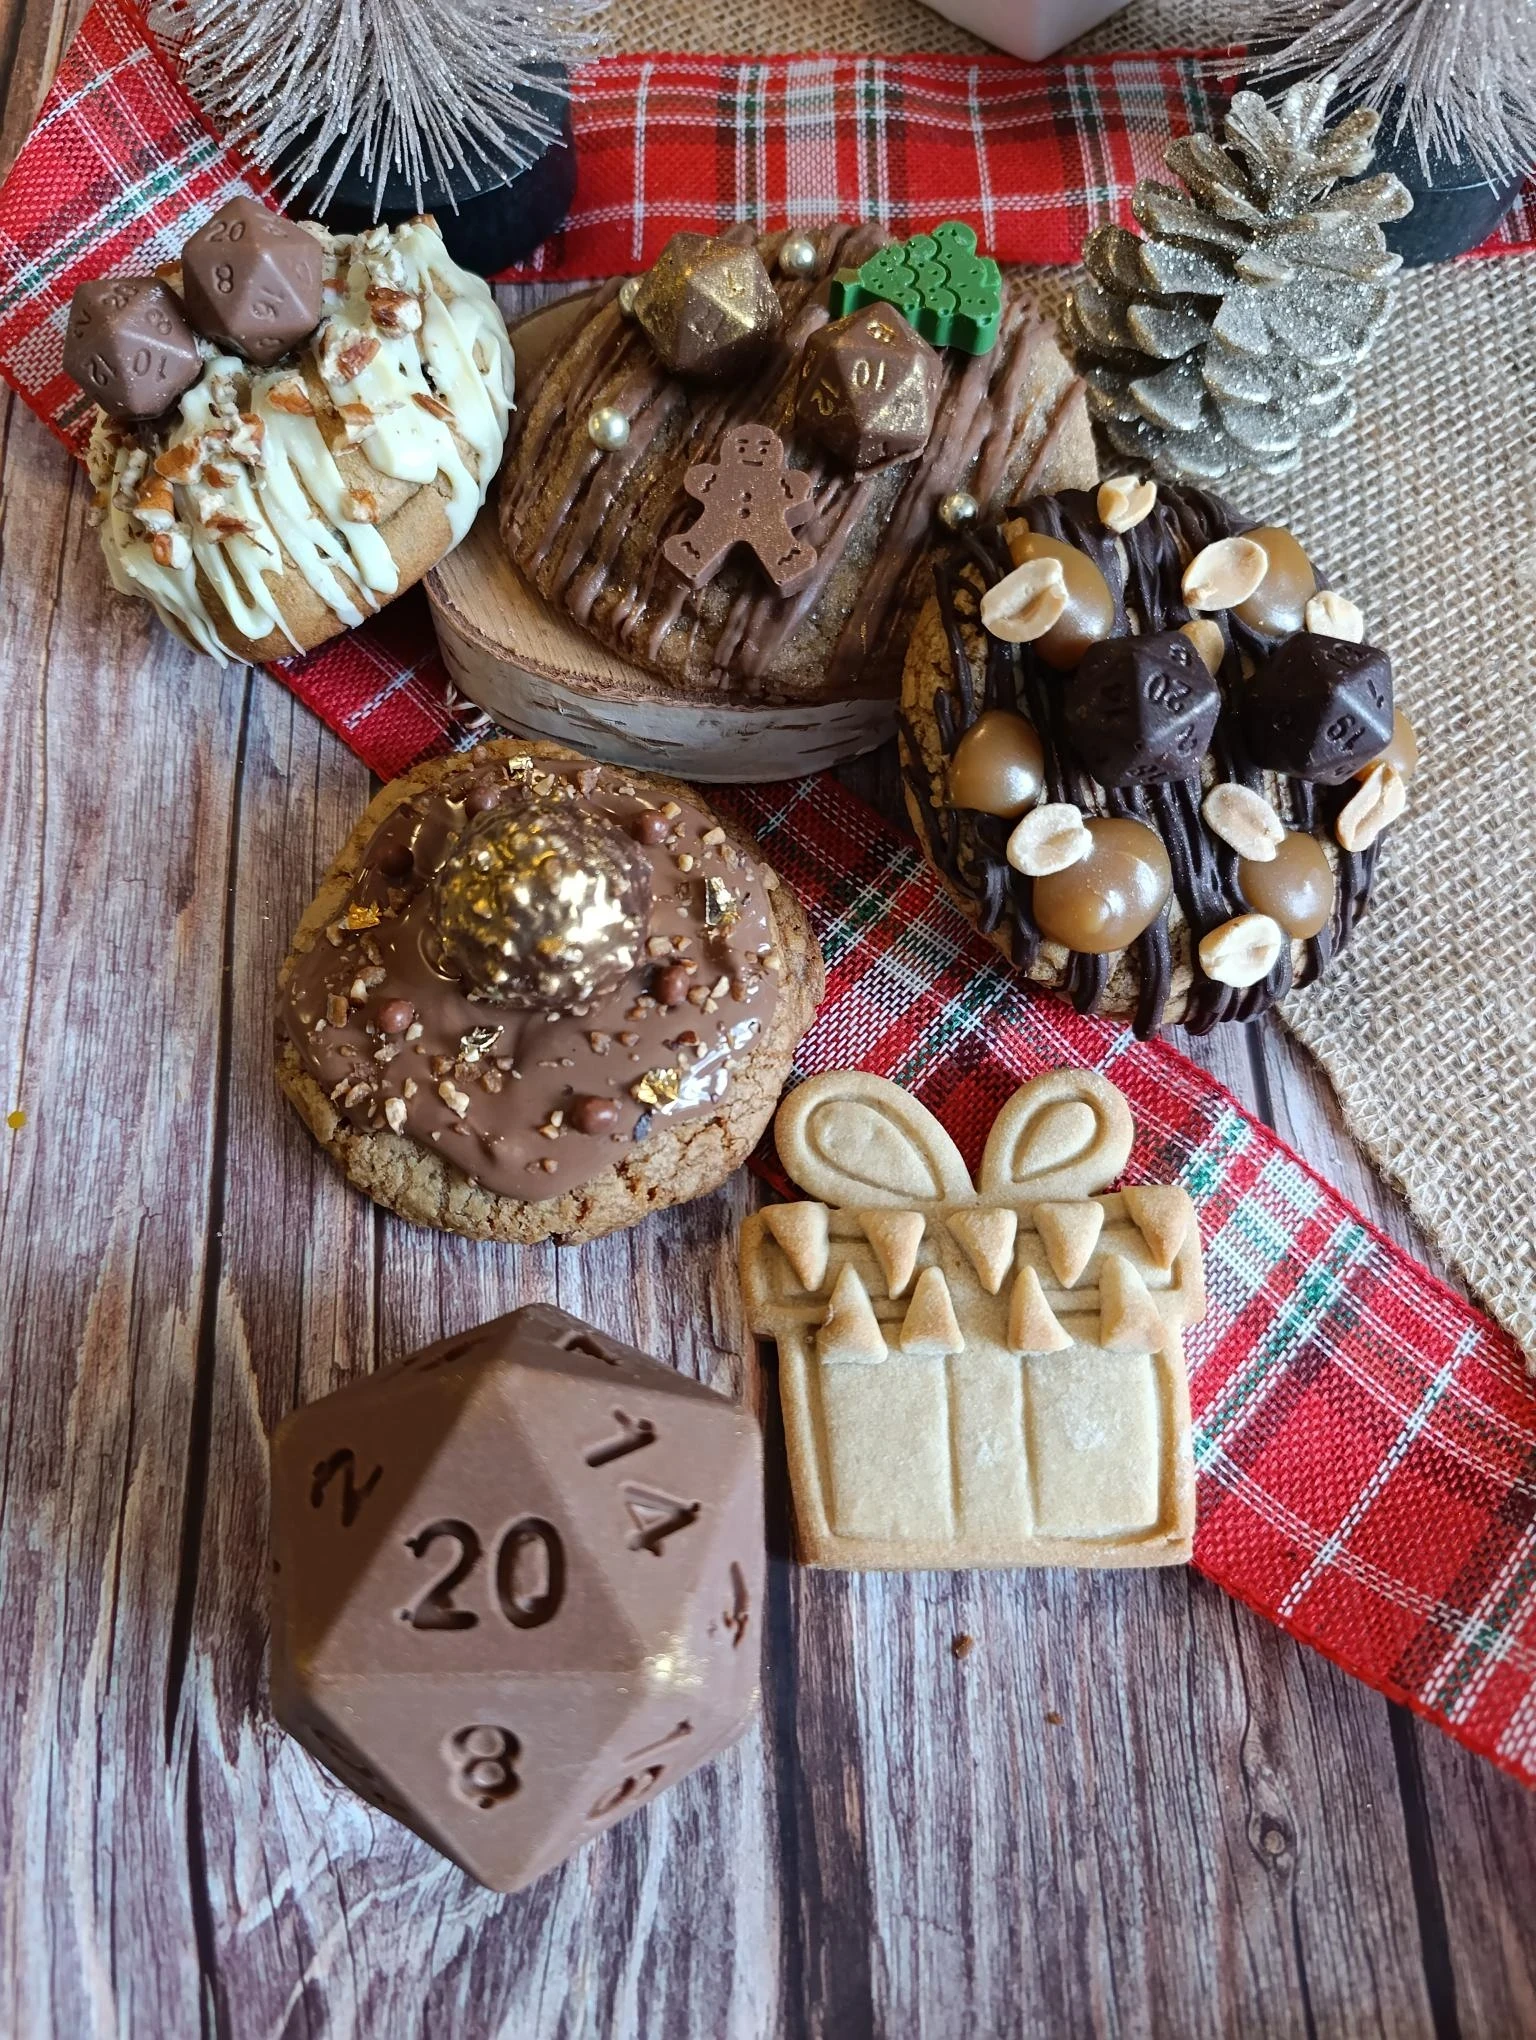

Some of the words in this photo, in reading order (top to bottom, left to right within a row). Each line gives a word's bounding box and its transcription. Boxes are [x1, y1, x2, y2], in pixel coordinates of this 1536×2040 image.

[205, 220, 246, 243] 20
[212, 264, 234, 294] 8
[310, 1447, 384, 1528] 2
[400, 1515, 568, 1632] 20
[449, 1724, 524, 1810] 8
